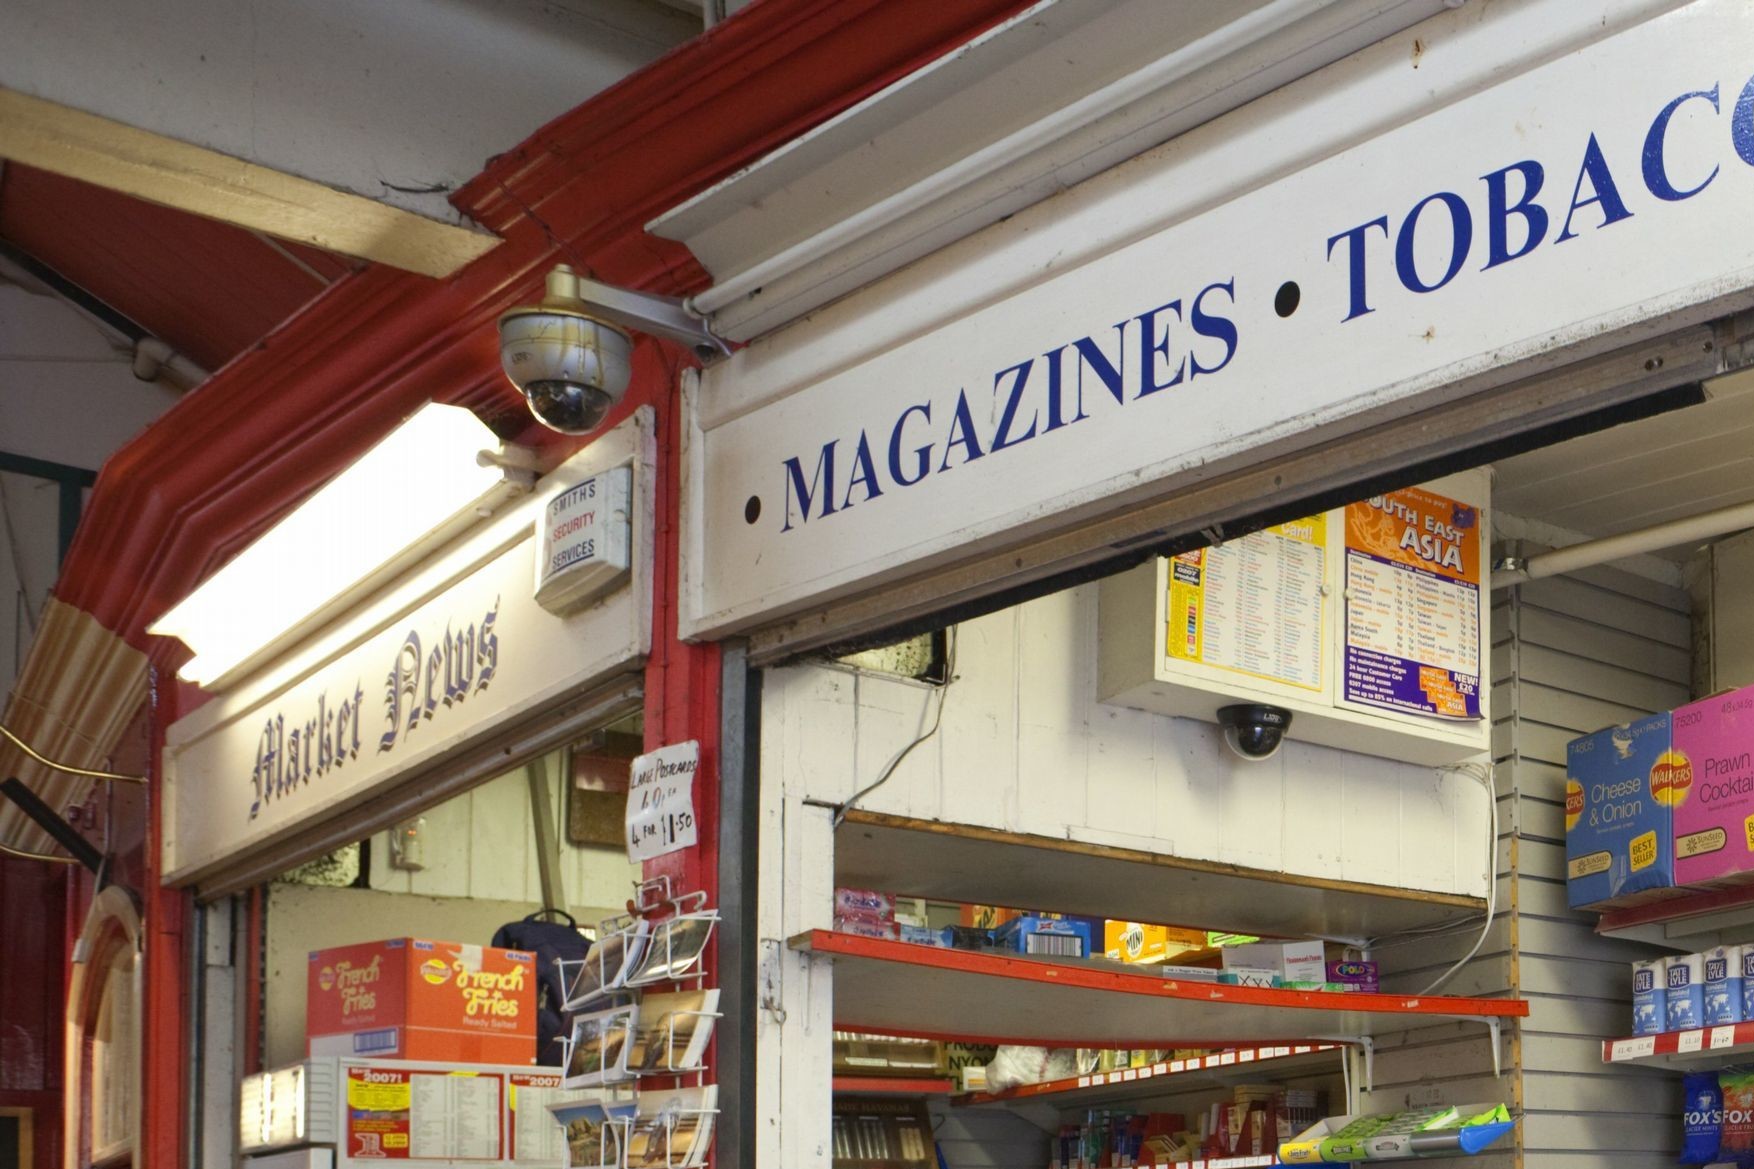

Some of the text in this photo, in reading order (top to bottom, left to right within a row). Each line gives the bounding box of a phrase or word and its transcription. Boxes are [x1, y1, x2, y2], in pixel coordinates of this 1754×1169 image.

[778, 278, 1238, 534] MAGAZINES
[554, 486, 596, 516] SMITHS
[552, 512, 595, 542] SECURITY
[1281, 522, 1313, 541] Card!
[1425, 515, 1464, 546] EAST
[552, 539, 594, 569] SERVICES
[1400, 526, 1464, 574] ASIA
[1454, 672, 1478, 686] NEW!
[249, 595, 500, 820] Market News
[1704, 752, 1751, 779] Prawn
[1591, 778, 1641, 804] Cheese
[1602, 800, 1642, 823] Onion
[632, 824, 640, 847] 4
[1633, 836, 1654, 856] BEST
[336, 955, 379, 989] French
[462, 990, 518, 1017] Fries
[463, 1016, 517, 1029] Ready Salted
[1684, 1109, 1721, 1125] FOX'S
